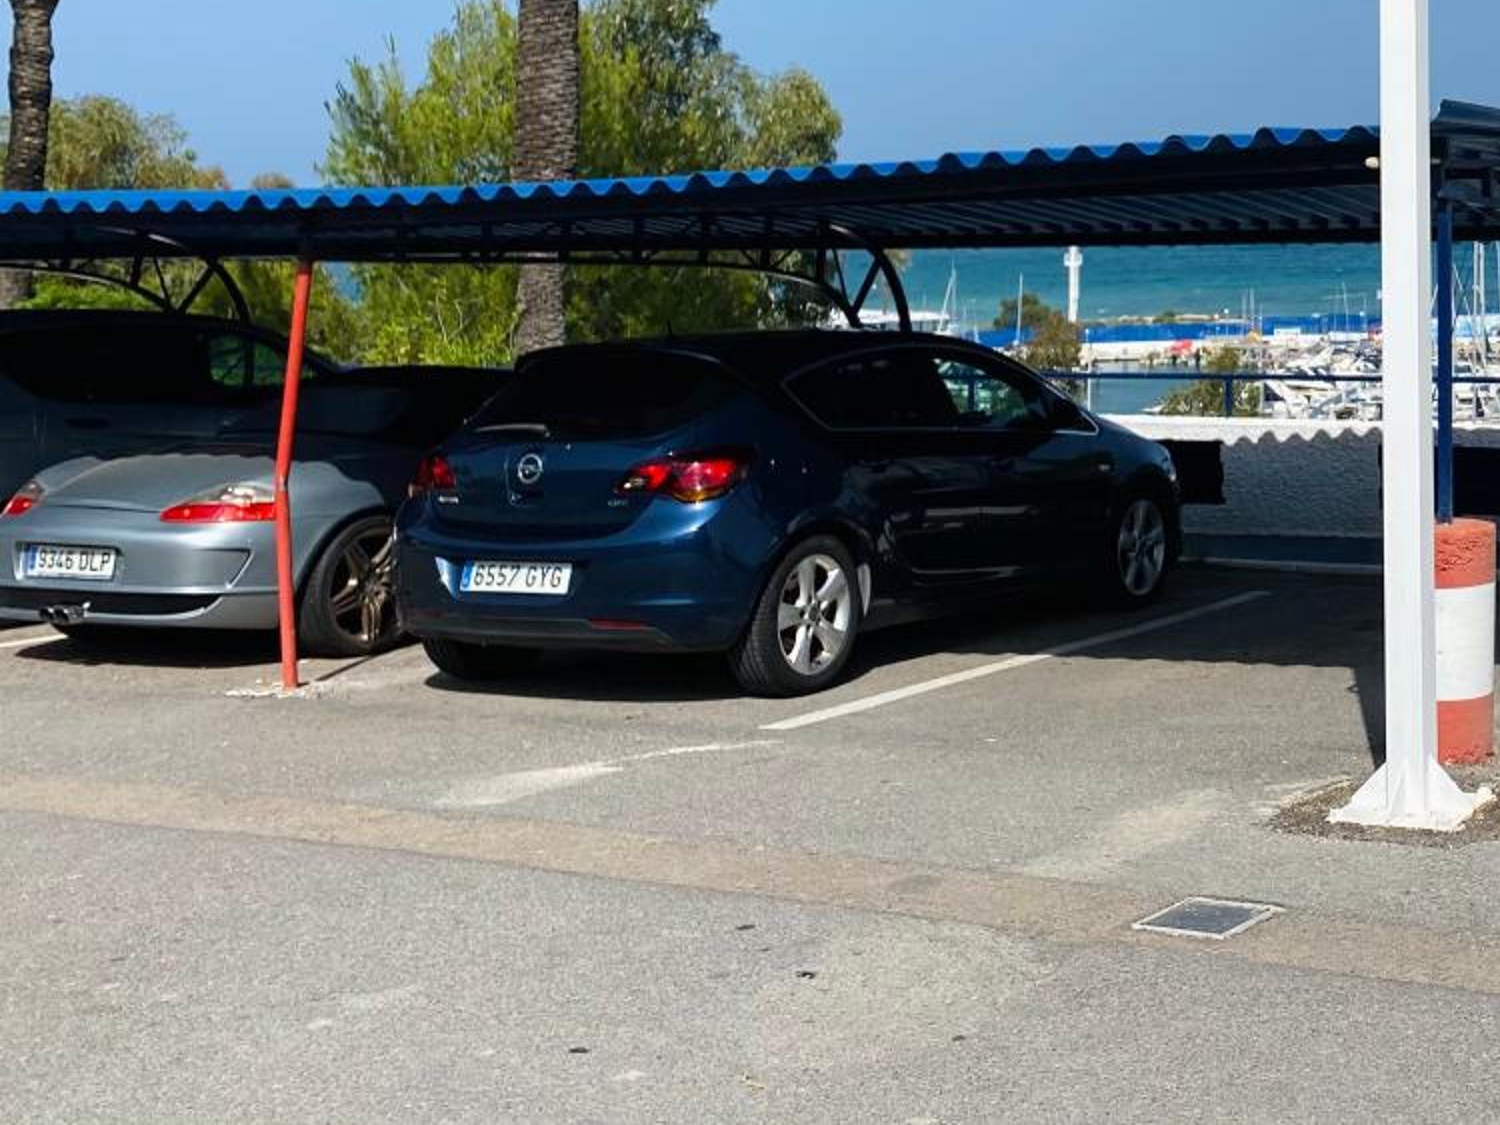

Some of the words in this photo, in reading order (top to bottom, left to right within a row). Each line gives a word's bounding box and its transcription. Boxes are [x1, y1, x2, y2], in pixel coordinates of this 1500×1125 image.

[78, 549, 111, 572] DLP
[473, 563, 521, 587] 6557
[525, 565, 563, 588] GYG
